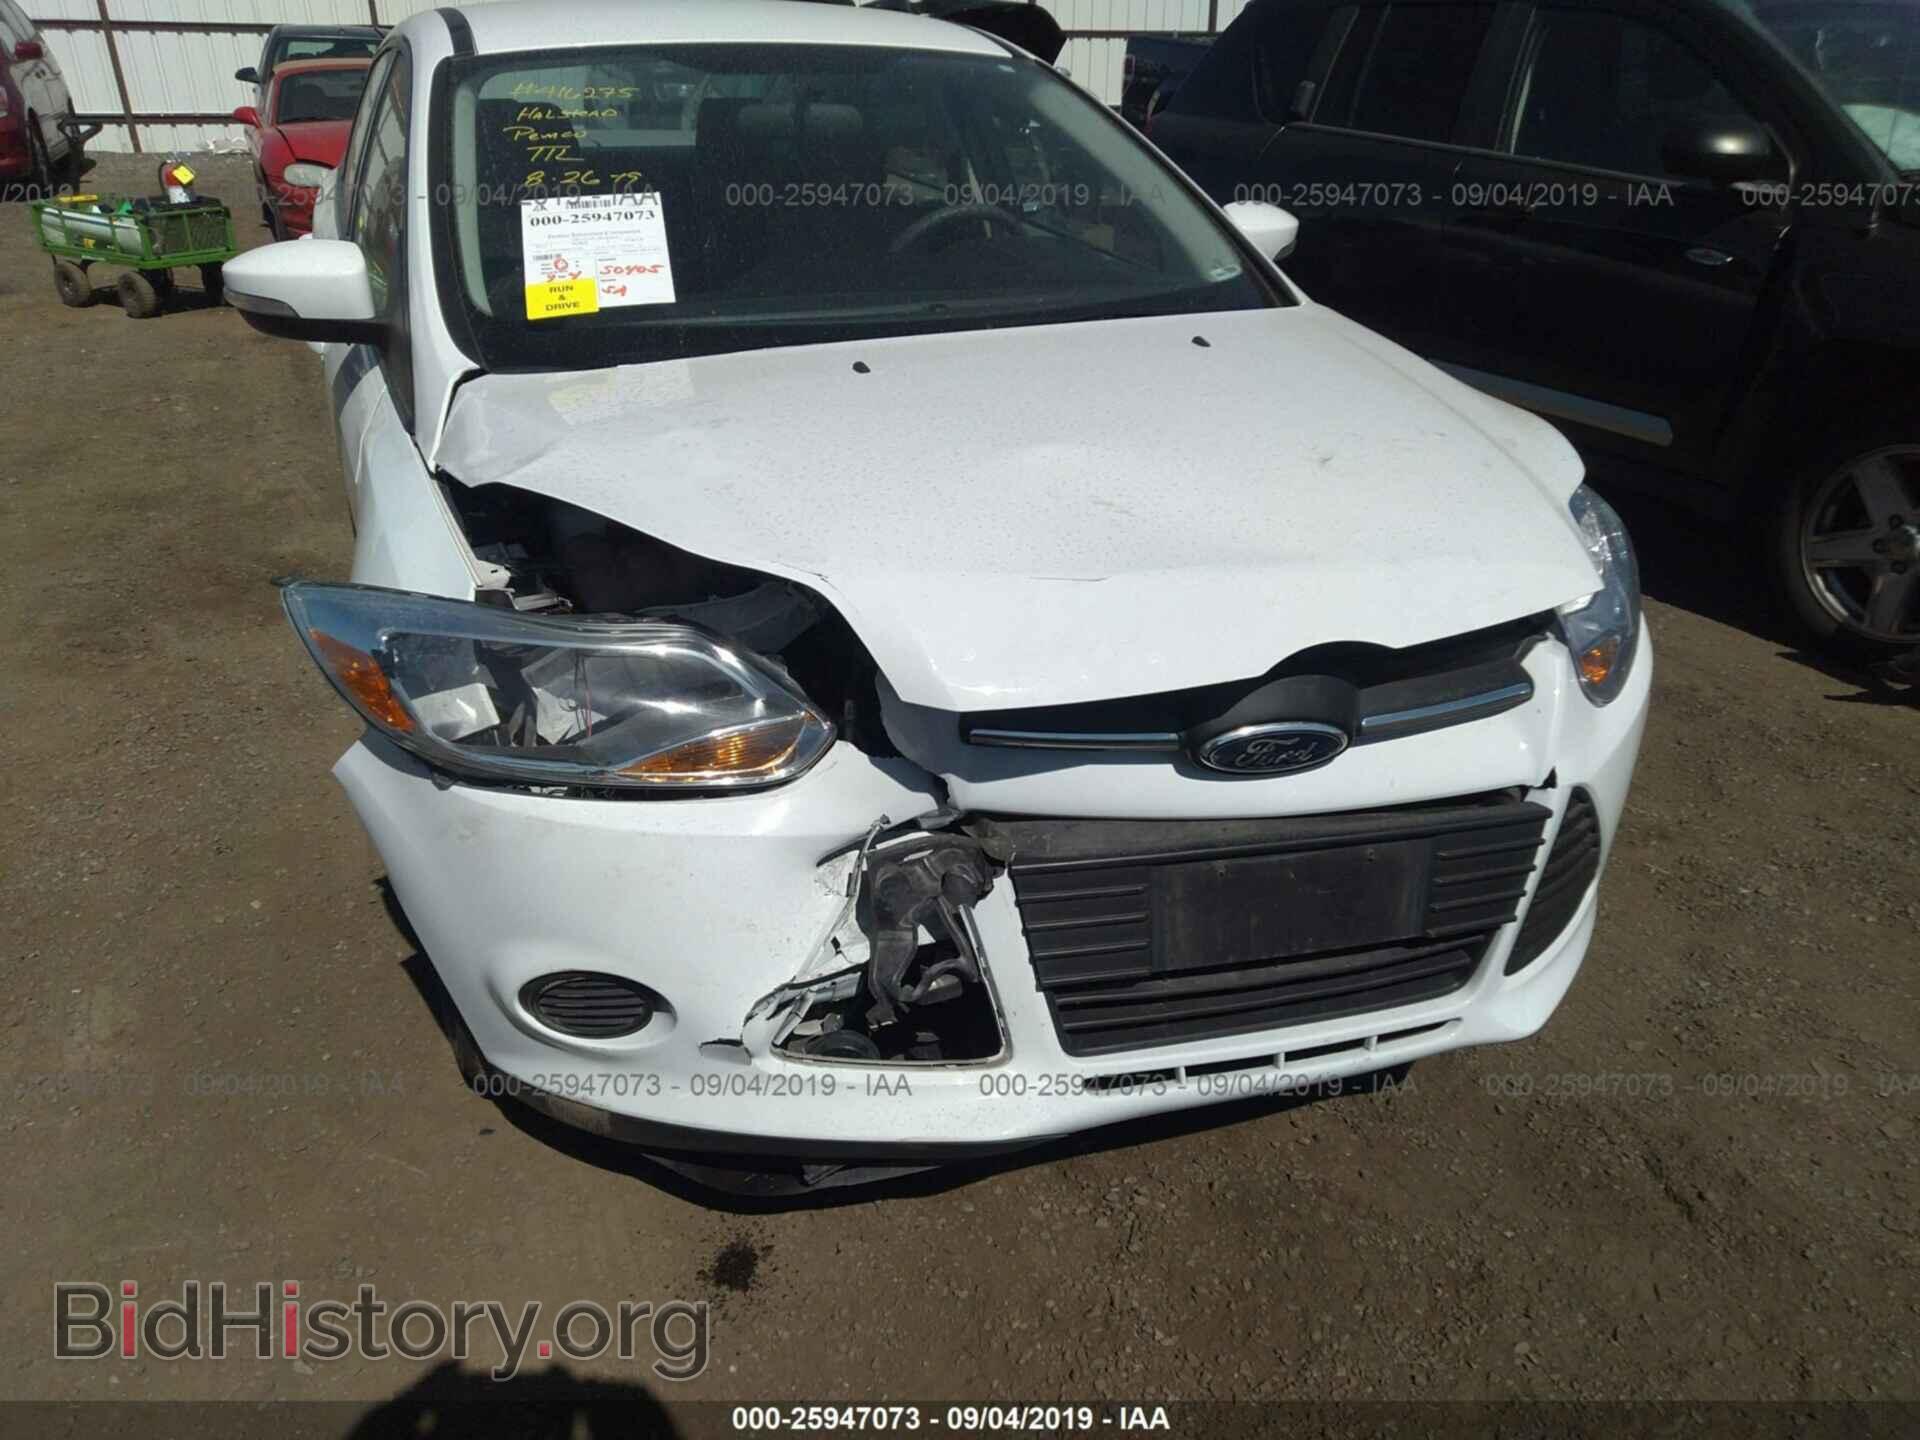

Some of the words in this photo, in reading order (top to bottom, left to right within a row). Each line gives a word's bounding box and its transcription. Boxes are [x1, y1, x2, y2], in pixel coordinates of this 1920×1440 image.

[530, 210, 656, 227] 000-25947073
[549, 285, 574, 294] RUN
[545, 301, 580, 311] DRIVE
[1235, 737, 1319, 767] Ford
